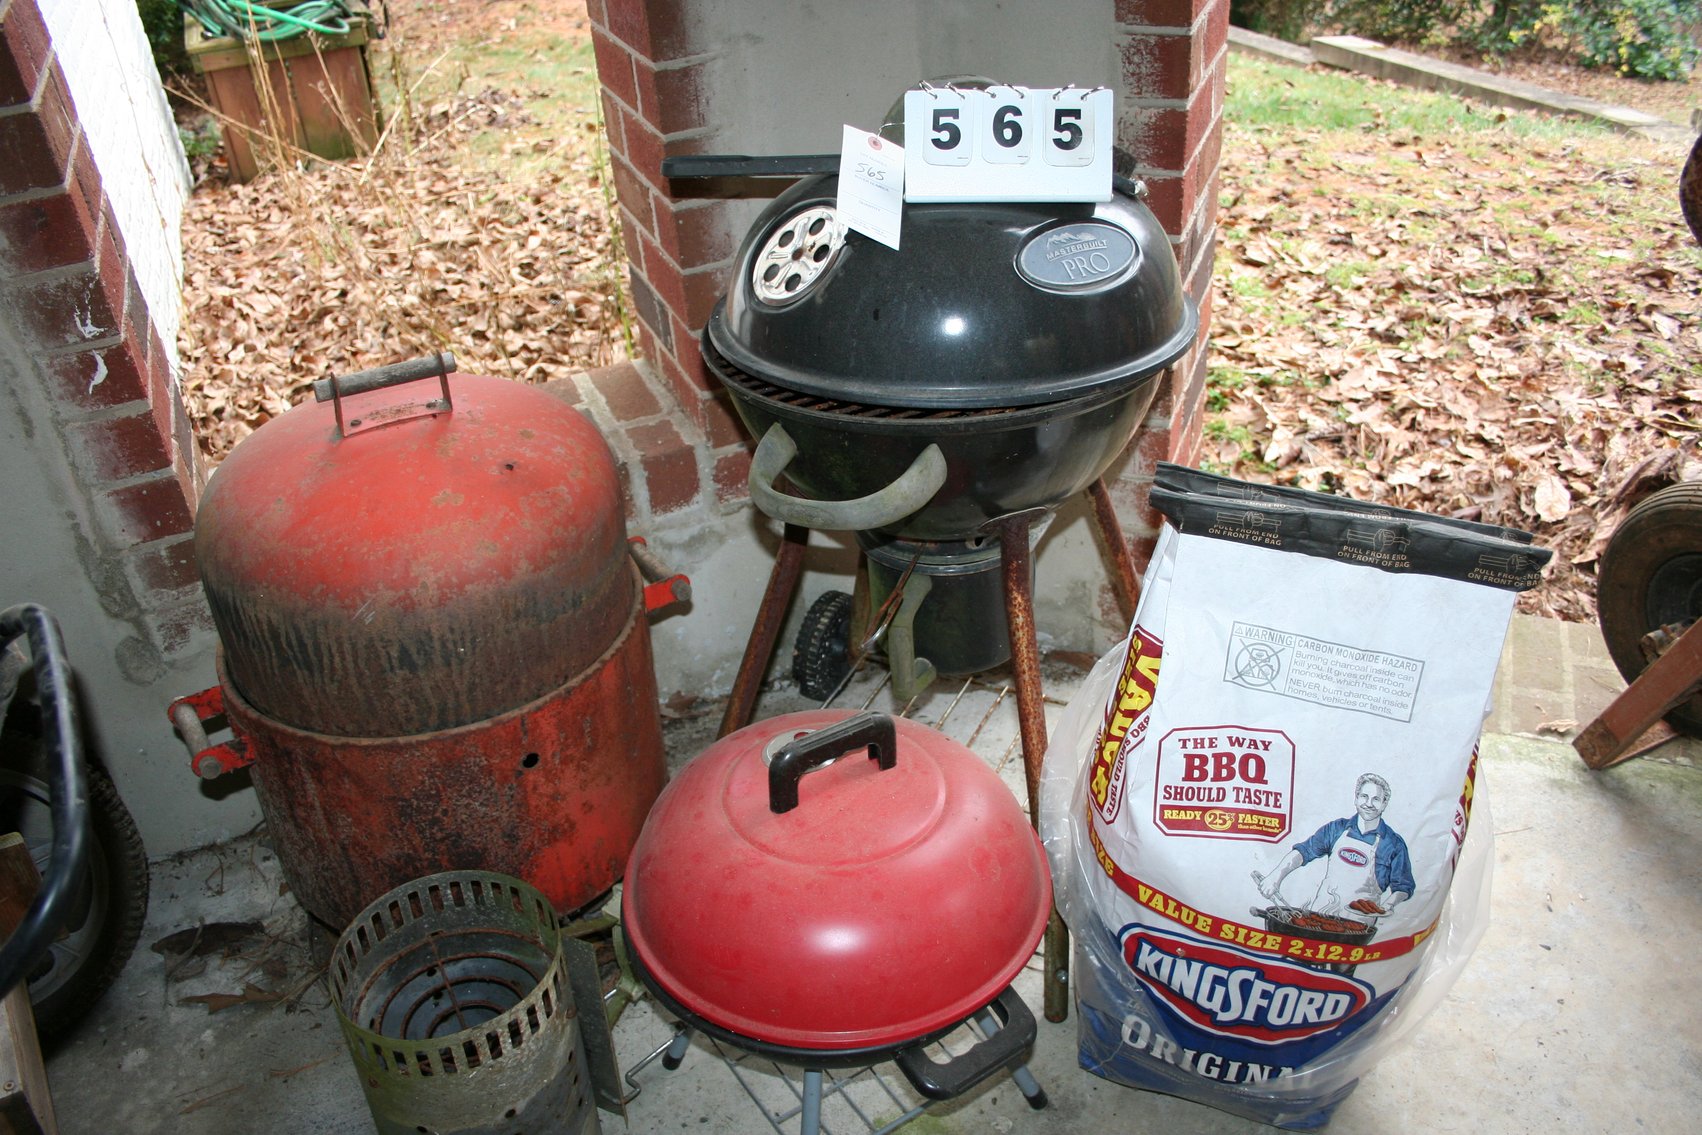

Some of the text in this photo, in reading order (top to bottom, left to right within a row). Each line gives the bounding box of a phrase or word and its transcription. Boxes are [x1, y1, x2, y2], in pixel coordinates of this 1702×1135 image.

[855, 162, 886, 181] 565
[1046, 240, 1108, 260] MASTERBUILT
[1061, 252, 1110, 280] PRO
[1208, 527, 1221, 535] ON
[1222, 530, 1250, 540] FRONT
[1264, 538, 1282, 546] BAG
[1214, 524, 1279, 539] PULL FROM END
[1343, 545, 1363, 554] PULL
[1365, 550, 1390, 560] FROM
[1351, 553, 1380, 564] FRONT
[1467, 572, 1481, 580] ON
[1482, 575, 1513, 586] FRONT
[1473, 567, 1495, 577] PULL
[1244, 626, 1293, 646] WARNING
[1297, 639, 1418, 672] CARBON MONOXIDE HAZARD
[1294, 659, 1305, 668] kill
[1326, 666, 1333, 674] It
[1333, 669, 1358, 680] gives
[1359, 673, 1373, 681] off
[1373, 676, 1405, 688] carbon
[1295, 650, 1414, 682] Burning charcoal inside can
[1287, 686, 1320, 700] homes,
[1321, 695, 1357, 706] vehicles
[1289, 678, 1321, 691] NEVER
[1343, 690, 1381, 703] charcoal
[1382, 698, 1409, 710] inside
[1336, 678, 1360, 688] which
[1361, 681, 1378, 691] has
[1379, 686, 1391, 694] no
[1391, 688, 1413, 699] odor.
[1178, 736, 1273, 751] THE WAY
[1181, 752, 1269, 785] BBQ
[1106, 783, 1118, 816] TASTE
[1163, 784, 1282, 809] SHOULD TASTE
[1163, 809, 1280, 828] READY 25% FASTER
[1137, 884, 1213, 933] VALUE
[1219, 923, 1282, 951] SIZE
[1136, 938, 1350, 1026] KINGSFORD
